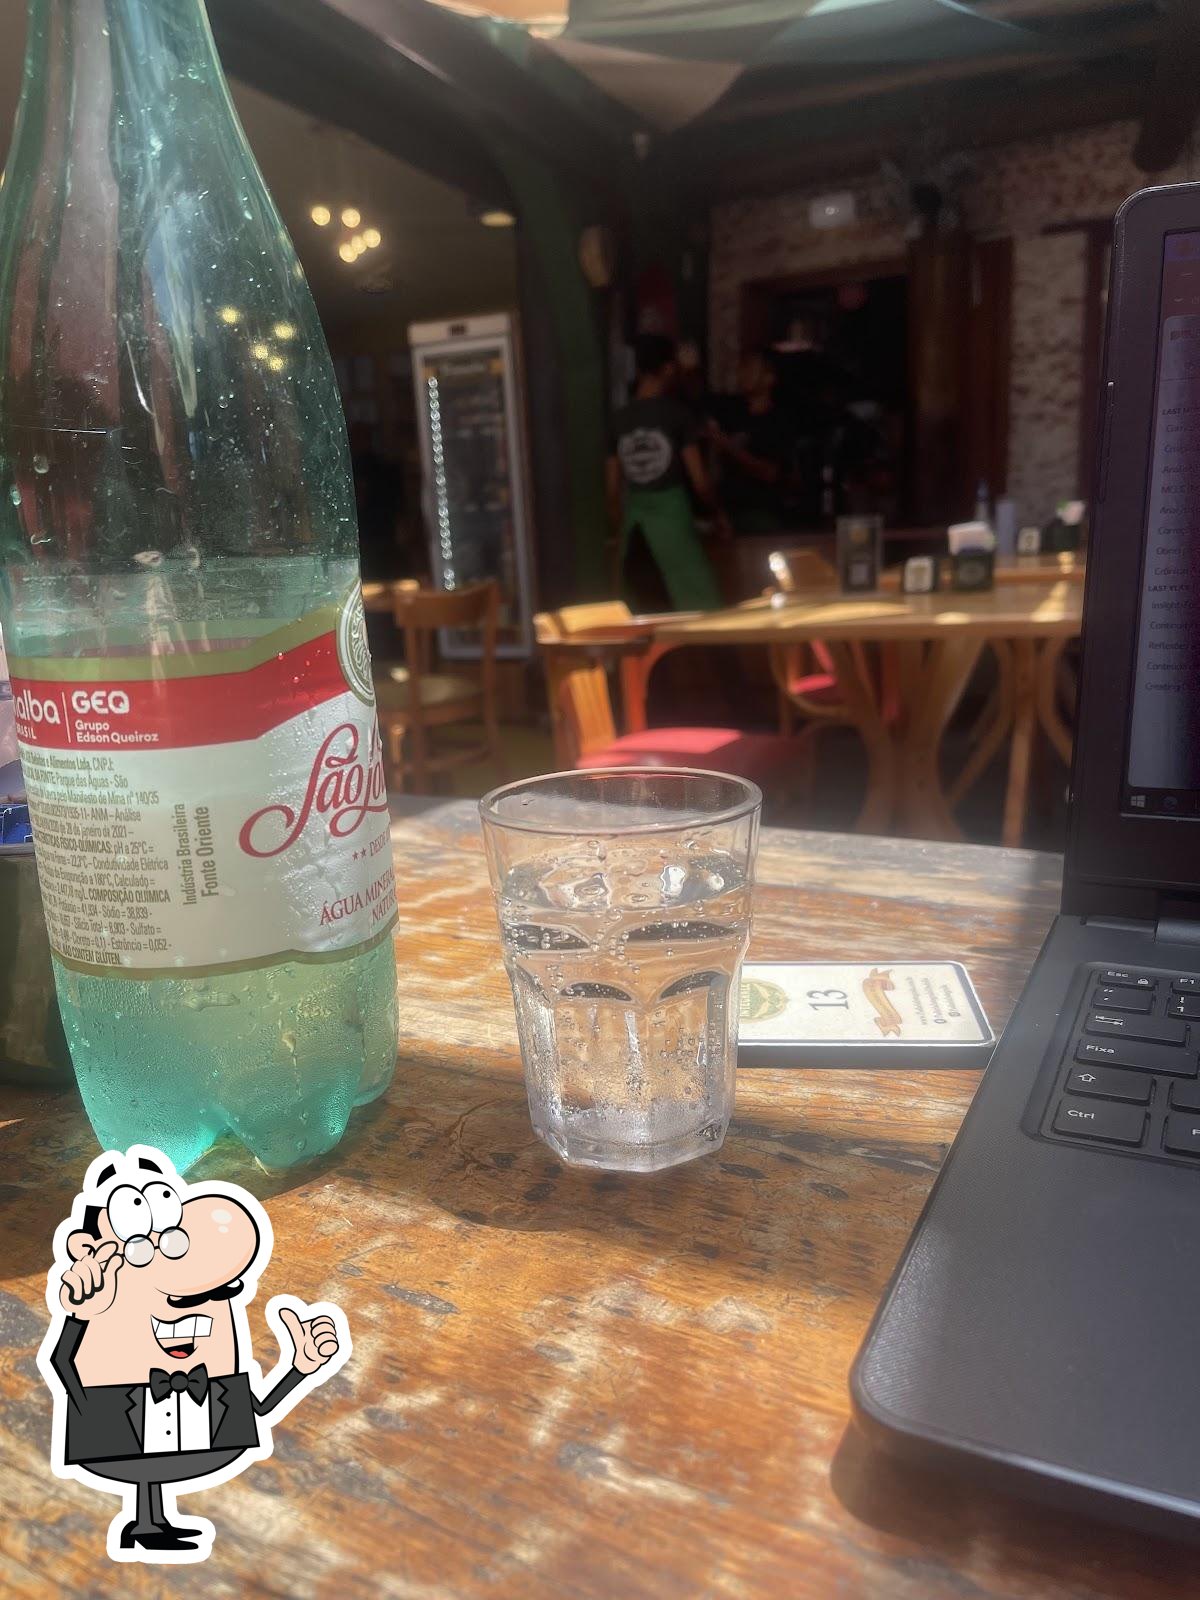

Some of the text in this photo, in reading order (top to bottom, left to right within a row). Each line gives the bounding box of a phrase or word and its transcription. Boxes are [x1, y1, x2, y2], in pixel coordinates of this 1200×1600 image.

[13, 689, 60, 724] alba
[72, 690, 130, 714] GEQ
[75, 720, 110, 733] Grupo
[76, 731, 159, 745] Edson Queiroz
[114, 774, 128, 788] São
[112, 825, 127, 839] 2021
[171, 803, 197, 906] Indústria Brasileira
[194, 806, 219, 897] Fonte Oriente
[140, 857, 168, 871] Elétrica
[89, 887, 134, 906] COMPOSIÇÃO
[320, 891, 364, 926] ÁGUA
[130, 922, 155, 935] Sulfato
[807, 989, 848, 1011] 13
[1086, 1044, 1115, 1055] Fixa
[1067, 1109, 1095, 1121] Ctrl
